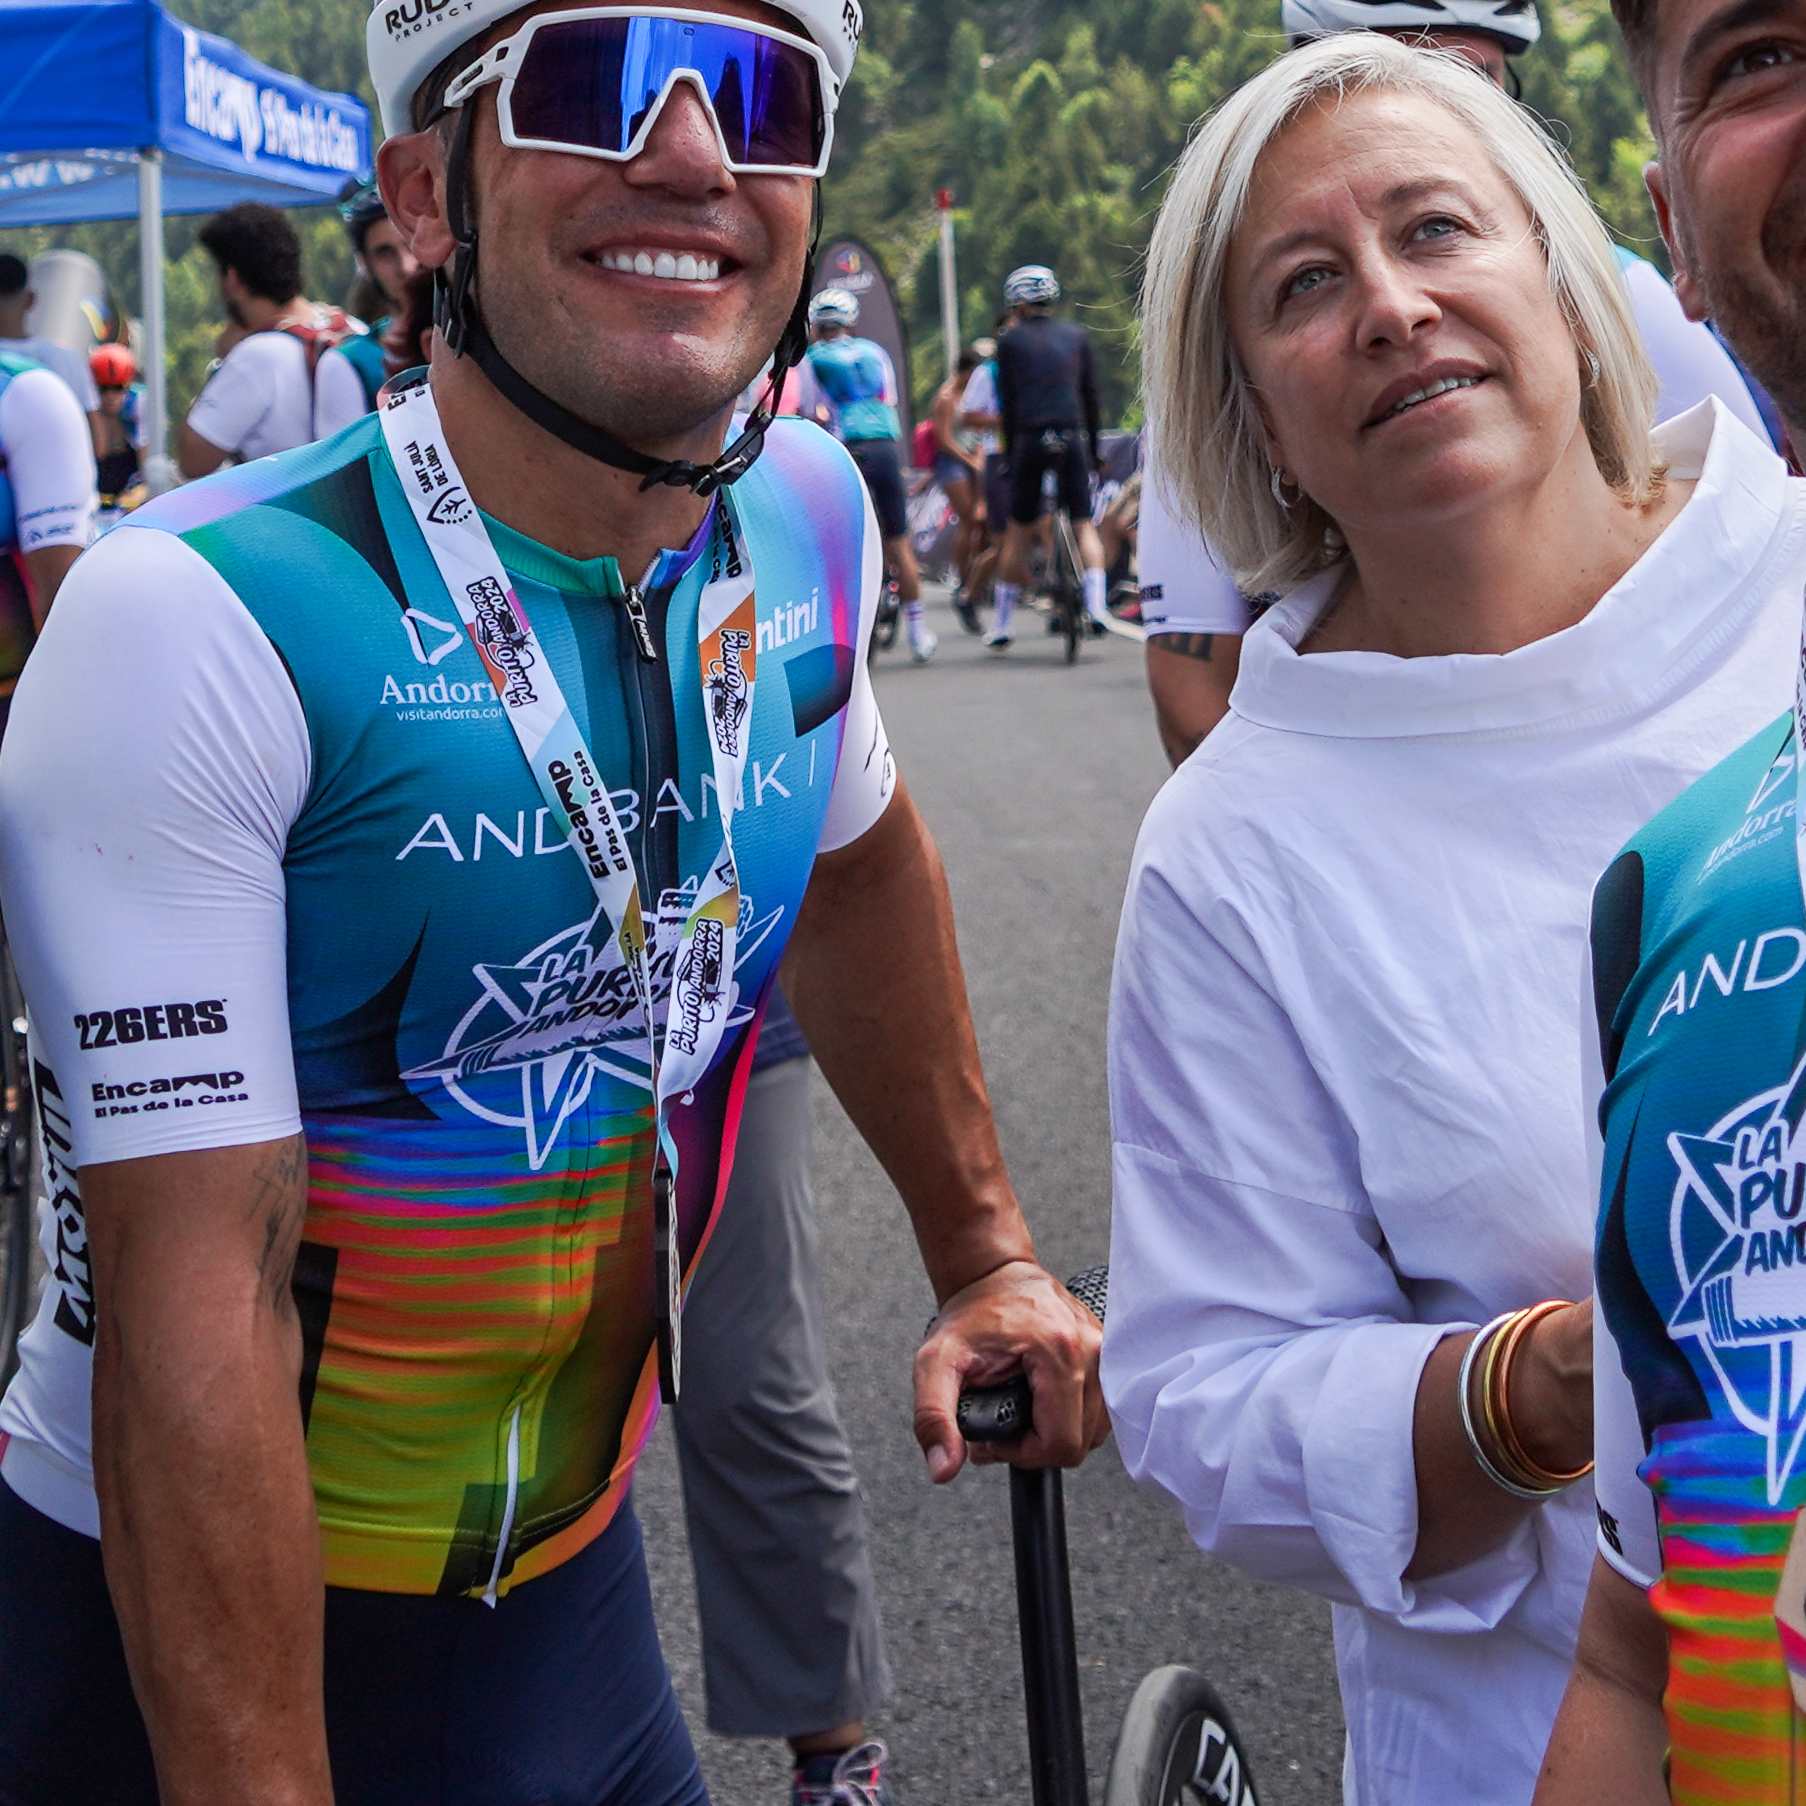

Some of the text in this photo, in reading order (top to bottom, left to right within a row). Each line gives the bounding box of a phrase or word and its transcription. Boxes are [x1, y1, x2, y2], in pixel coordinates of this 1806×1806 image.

[395, 2, 473, 43] PROJECT
[842, 0, 862, 41] RU
[415, 468, 434, 494] SANT
[434, 471, 449, 487] DE
[716, 496, 743, 579] camp
[482, 577, 509, 614] 2024
[738, 630, 751, 650] LA
[756, 587, 820, 655] ntini
[467, 583, 538, 706] PURITO ANDORRA
[722, 630, 741, 691] PURITO
[380, 673, 495, 705] Andorr
[506, 692, 521, 707] LA
[548, 760, 611, 879] Encamp
[573, 750, 628, 872] El Pas de la Casa
[706, 920, 723, 963] 2024
[547, 948, 588, 978] LA
[680, 919, 710, 1056] PURITO ANDORRA
[74, 999, 229, 1051] 226ERS
[670, 1031, 683, 1050] LA
[92, 1071, 245, 1102] Encamp
[95, 1092, 249, 1118] El Pas de la Casa
[1739, 1126, 1782, 1171] LA
